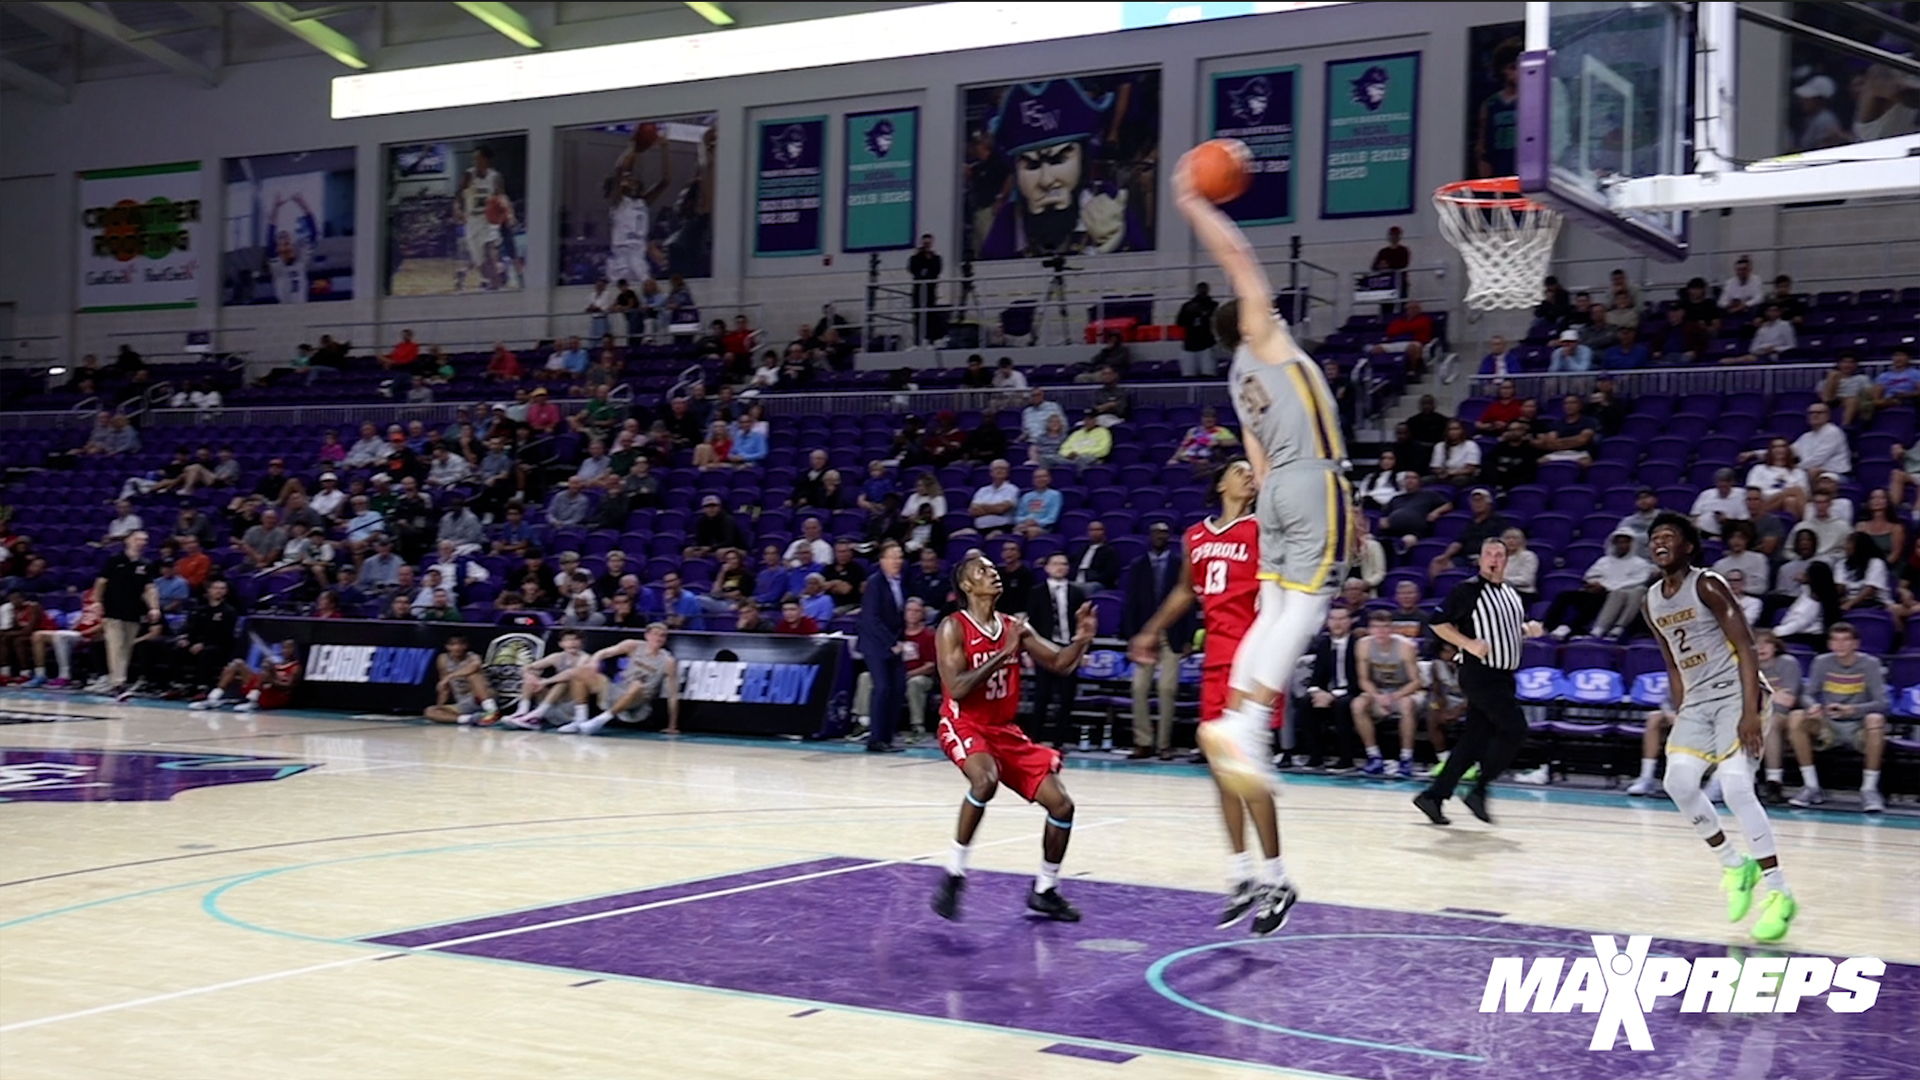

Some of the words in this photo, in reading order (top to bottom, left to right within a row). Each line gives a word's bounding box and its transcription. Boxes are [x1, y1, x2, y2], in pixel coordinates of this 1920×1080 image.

[1020, 100, 1061, 132] FSW
[1204, 560, 1228, 596] 13
[1673, 627, 1692, 653] 2
[985, 667, 1009, 700] 55
